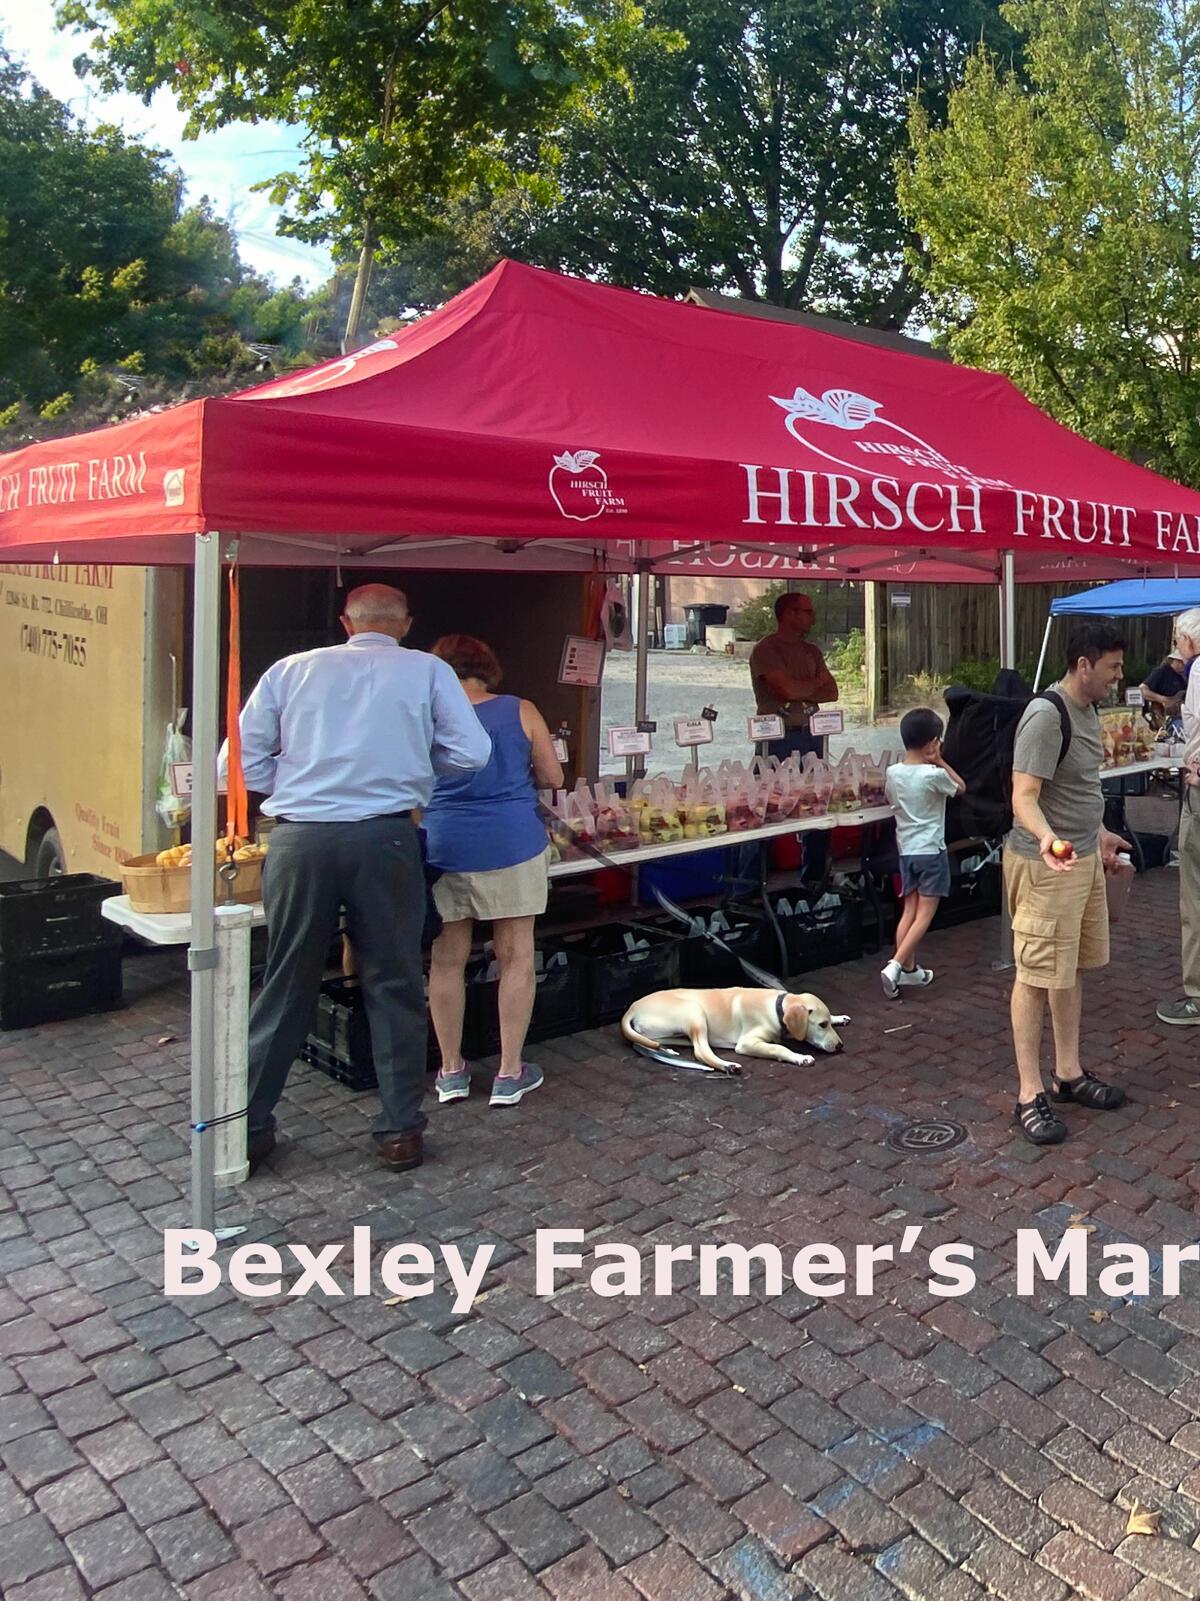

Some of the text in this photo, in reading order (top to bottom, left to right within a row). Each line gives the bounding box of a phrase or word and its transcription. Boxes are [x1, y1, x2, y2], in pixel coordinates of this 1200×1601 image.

[28, 462, 80, 506] FRUIT
[87, 450, 147, 501] FARM
[570, 480, 608, 490] HIRSCH
[581, 489, 614, 498] FRUIT
[595, 497, 625, 506] FARM
[739, 463, 987, 534] HIRSCH
[1012, 488, 1137, 547] FRUIT
